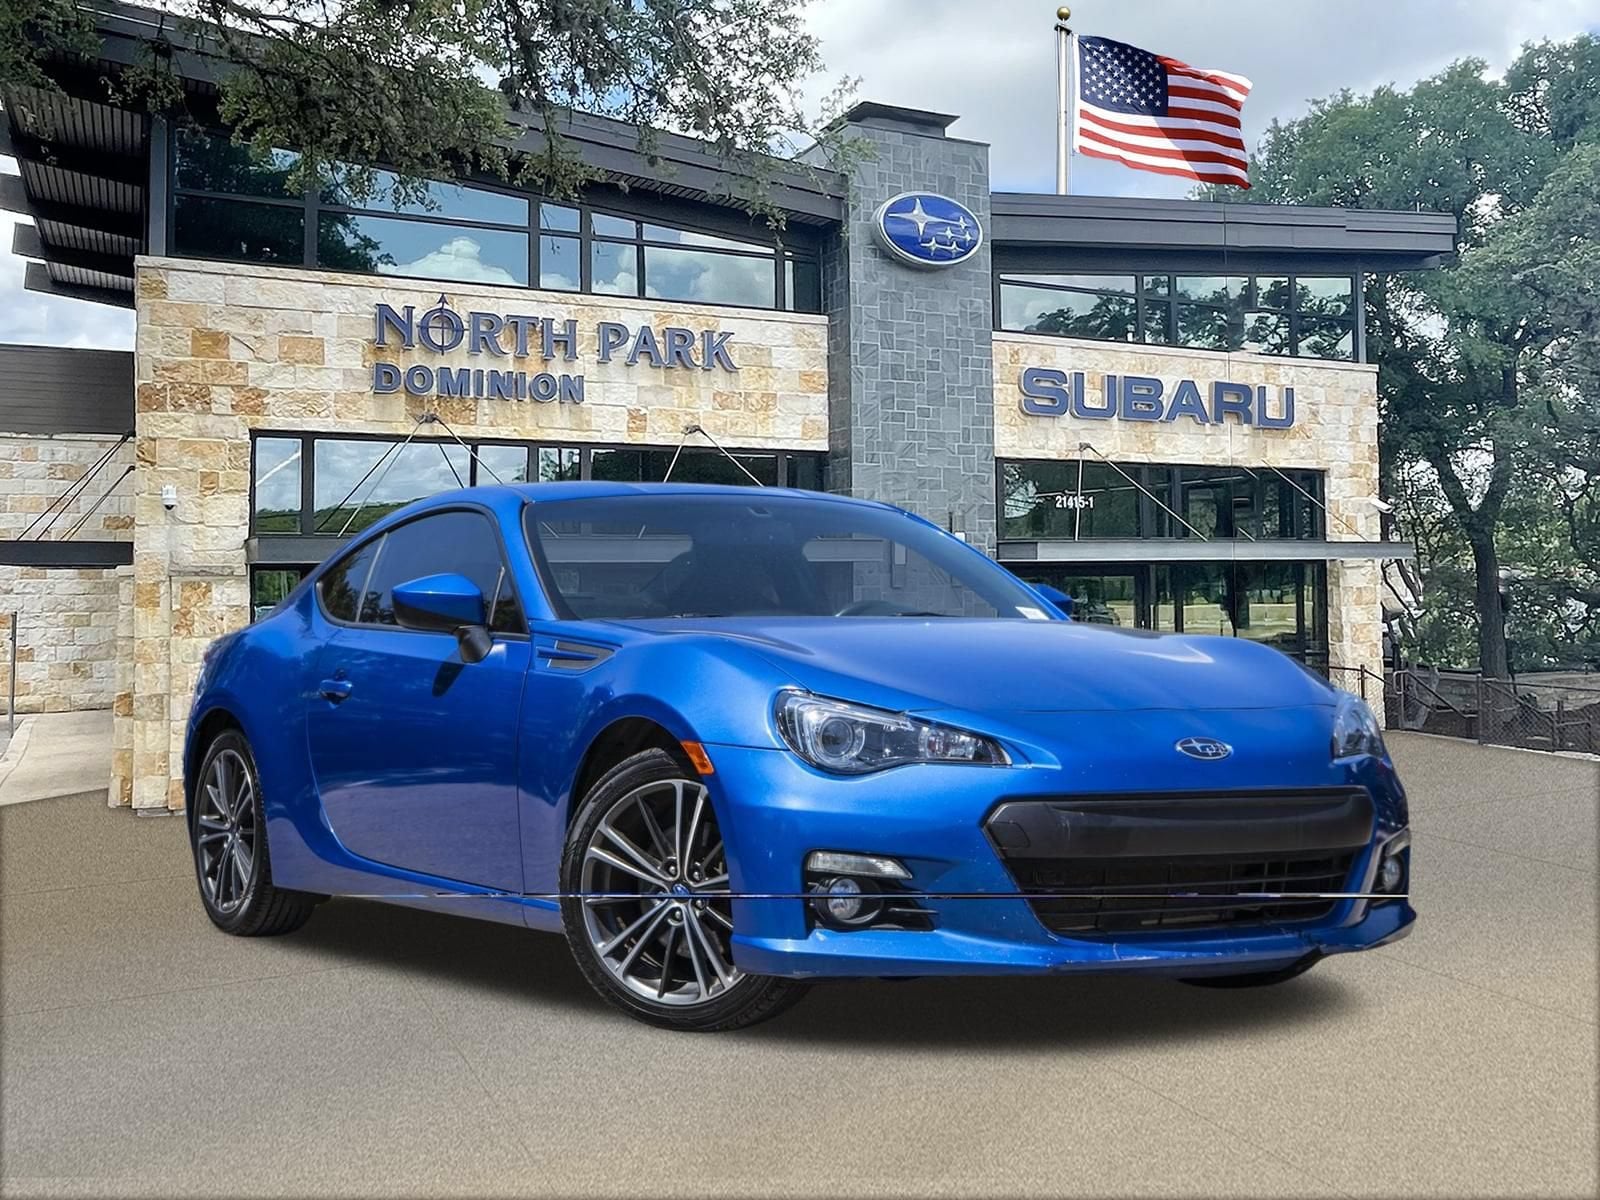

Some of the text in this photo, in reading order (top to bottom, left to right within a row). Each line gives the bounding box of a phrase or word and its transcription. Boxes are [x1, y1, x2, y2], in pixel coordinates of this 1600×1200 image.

[374, 302, 742, 373] NORTH PARK
[372, 361, 585, 403] DOMINION
[1018, 366, 1295, 430] SUBARU
[1055, 495, 1094, 509] 21415-1
